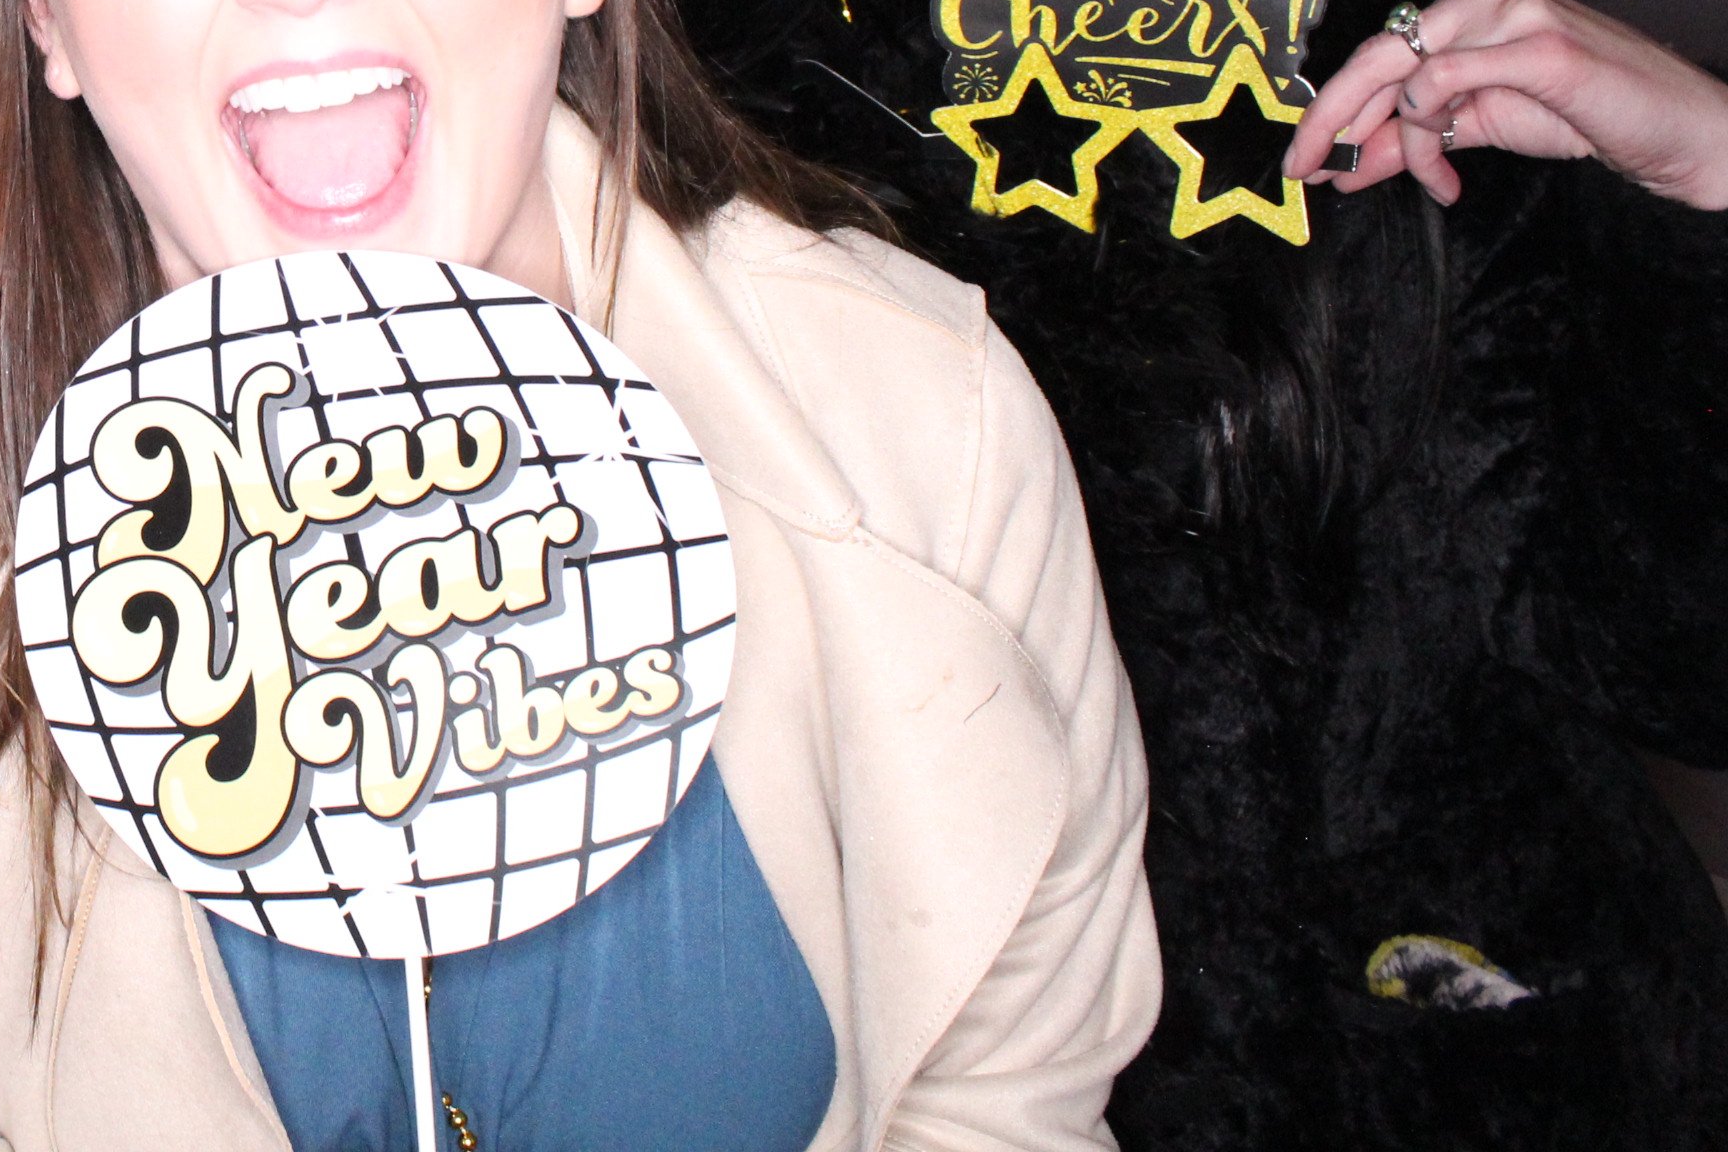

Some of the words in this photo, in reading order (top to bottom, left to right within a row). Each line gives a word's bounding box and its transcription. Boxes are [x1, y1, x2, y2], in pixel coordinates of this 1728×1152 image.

[90, 361, 512, 586] New
[71, 504, 588, 860] Year
[280, 639, 686, 820] Vibes
